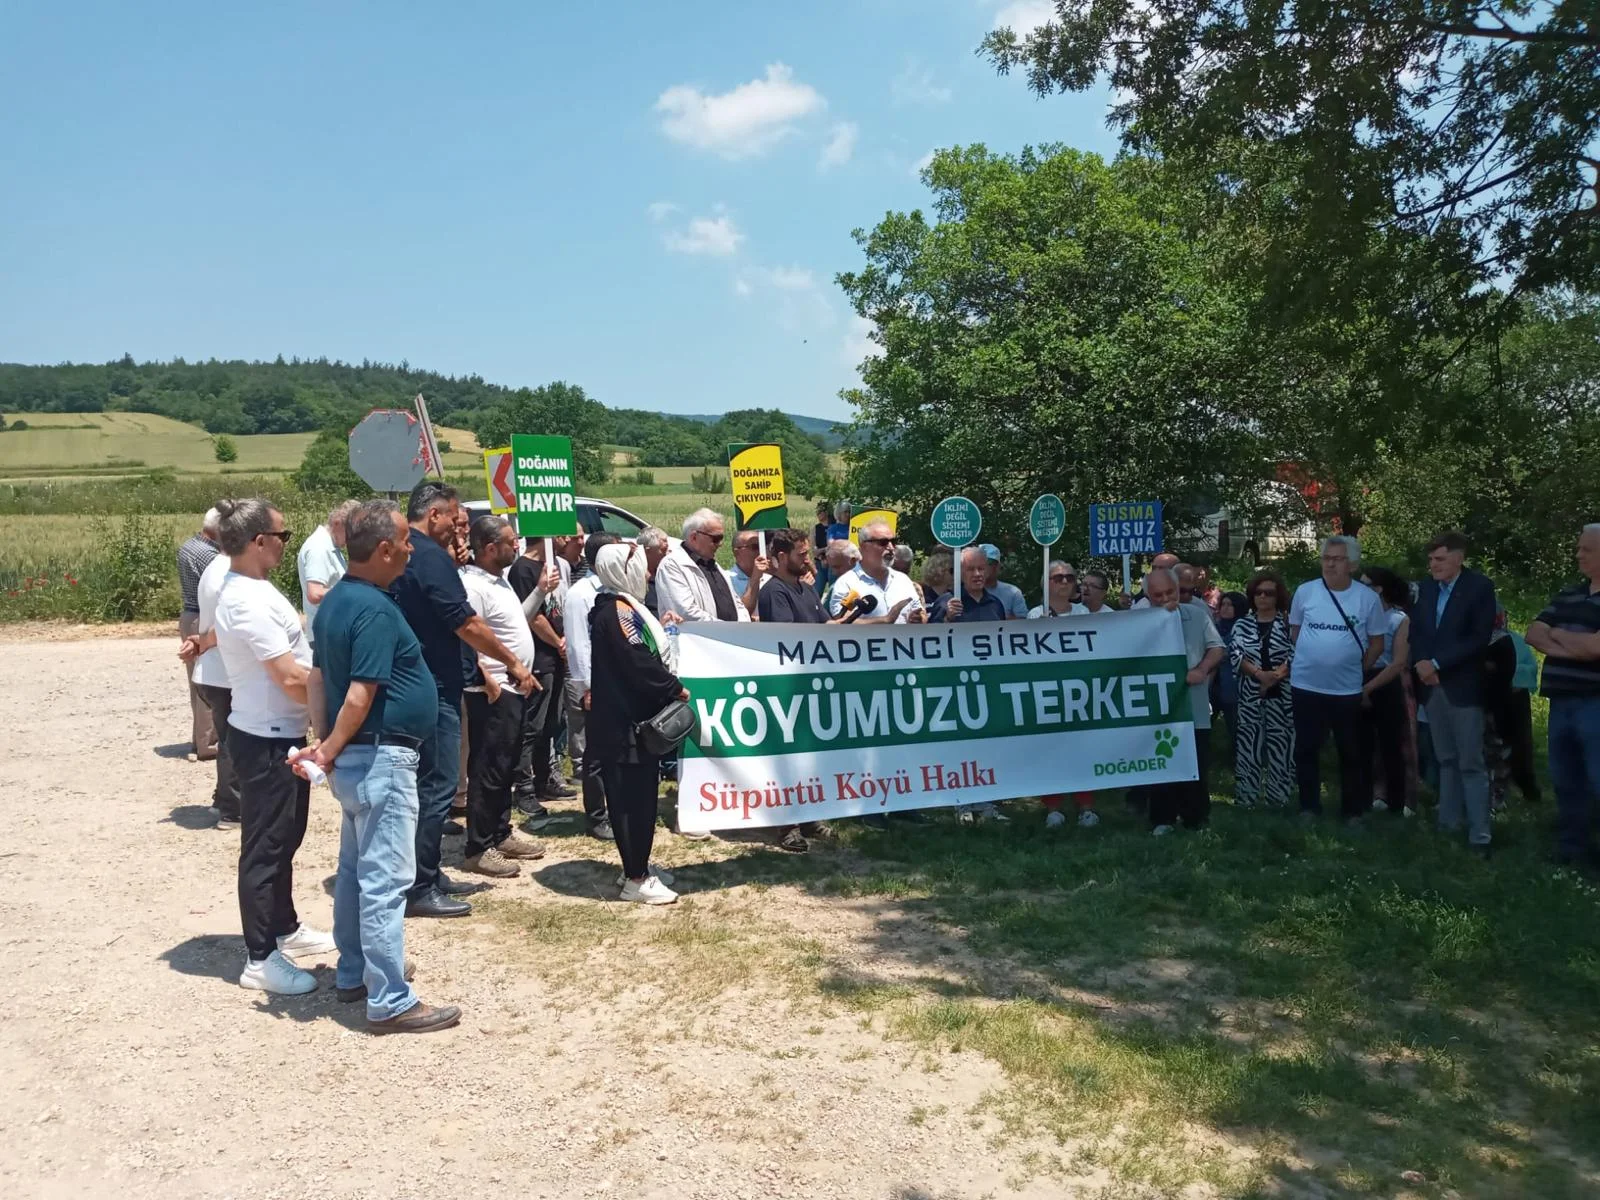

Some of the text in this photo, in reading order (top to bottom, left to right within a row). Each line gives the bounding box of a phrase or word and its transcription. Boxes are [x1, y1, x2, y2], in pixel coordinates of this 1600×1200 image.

[518, 455, 568, 470] DOĞANIN
[733, 467, 780, 477] DOĞAMIZA
[518, 475, 571, 487] TALANINA
[744, 479, 771, 490] SAHİP
[519, 493, 573, 512] HAYIR
[736, 492, 783, 505] ÇIKIYORUZ
[1097, 505, 1155, 521] SUSMA
[1097, 521, 1156, 538] SUSUZ
[1098, 537, 1155, 554] KALMA
[778, 627, 1097, 666] MADENCİ ŞİRKET
[696, 670, 1176, 748] KÖYÜMÜZÜ TERKET
[1094, 757, 1167, 777] DOĞADER
[700, 760, 997, 820] Süpürtü Köyü Halkı
